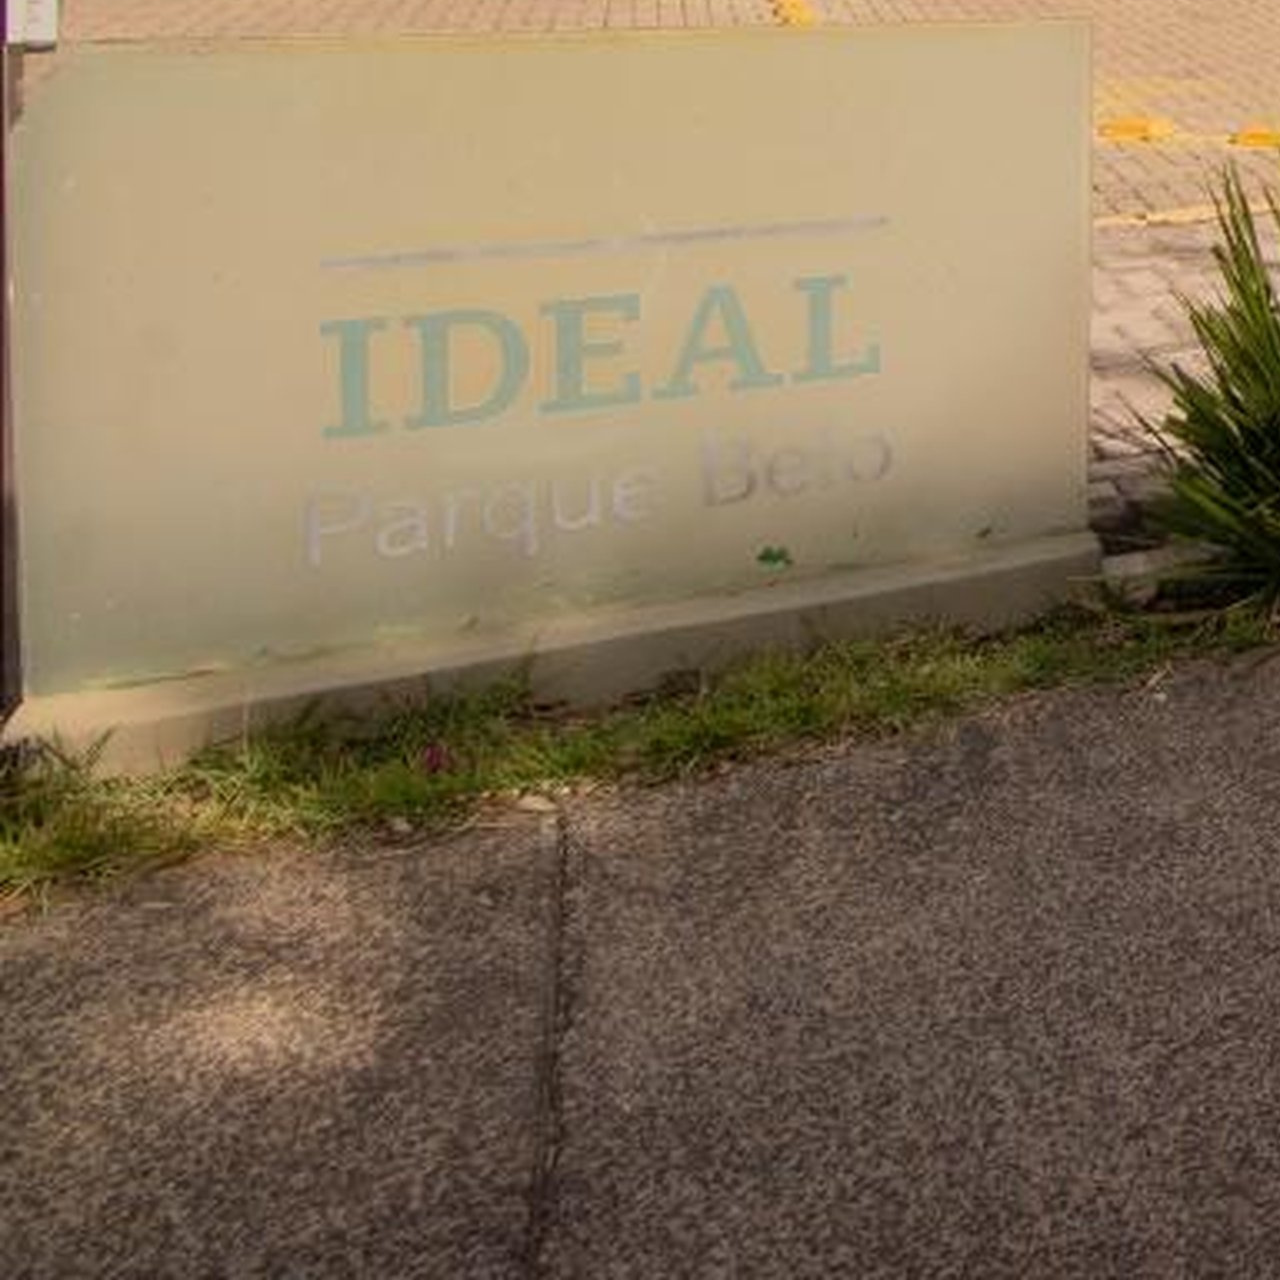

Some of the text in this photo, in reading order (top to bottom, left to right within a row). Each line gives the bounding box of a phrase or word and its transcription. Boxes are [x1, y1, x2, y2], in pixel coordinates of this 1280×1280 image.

[319, 274, 881, 440] IDEAL
[303, 423, 894, 566] Parque Belo
